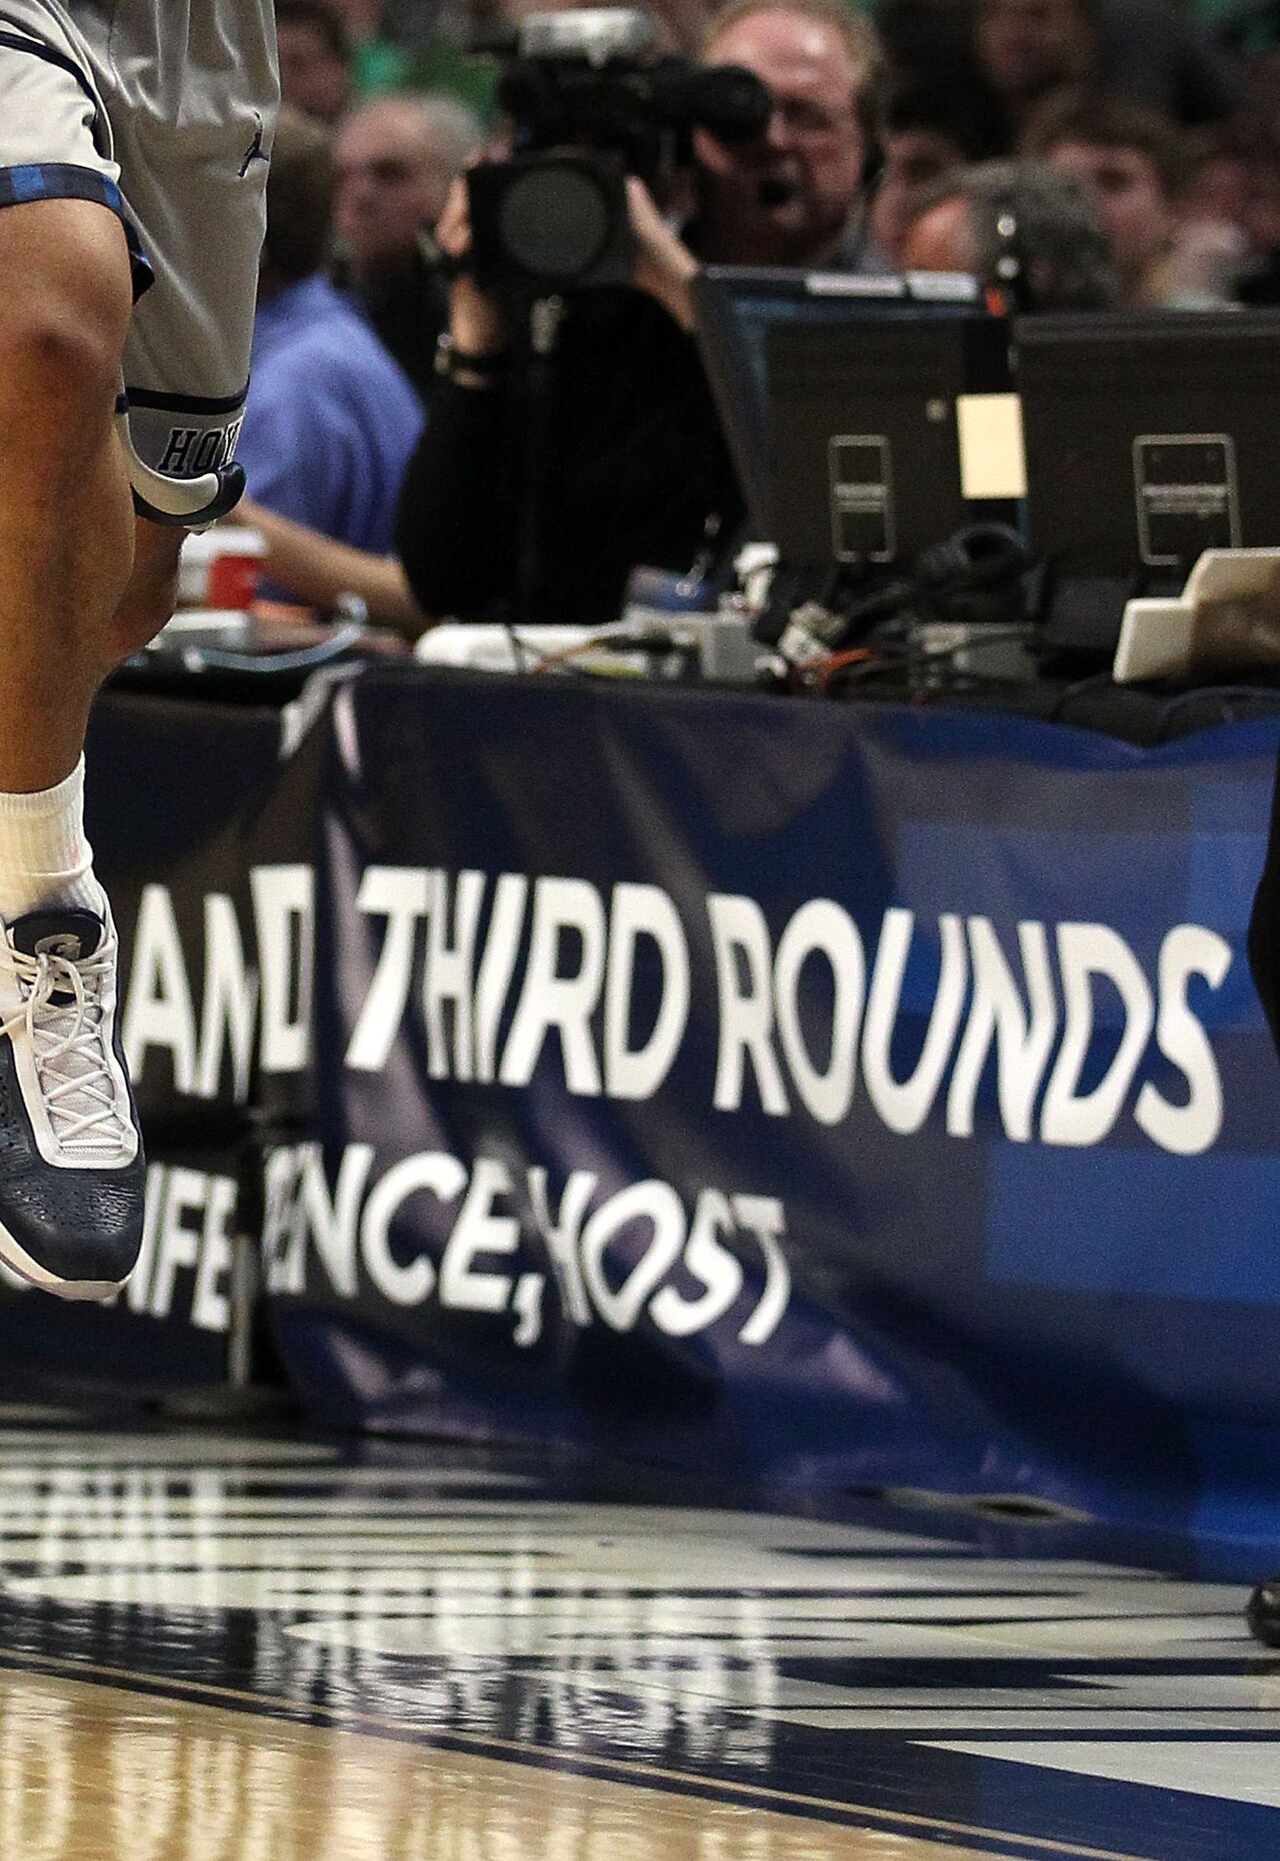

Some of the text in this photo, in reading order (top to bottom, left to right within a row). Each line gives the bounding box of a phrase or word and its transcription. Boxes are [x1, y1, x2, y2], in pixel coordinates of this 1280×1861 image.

[122, 863, 315, 1106] AND
[345, 866, 691, 1101] THIRD
[707, 891, 1232, 1155] ROUNDS
[526, 1164, 792, 1344] HOST
